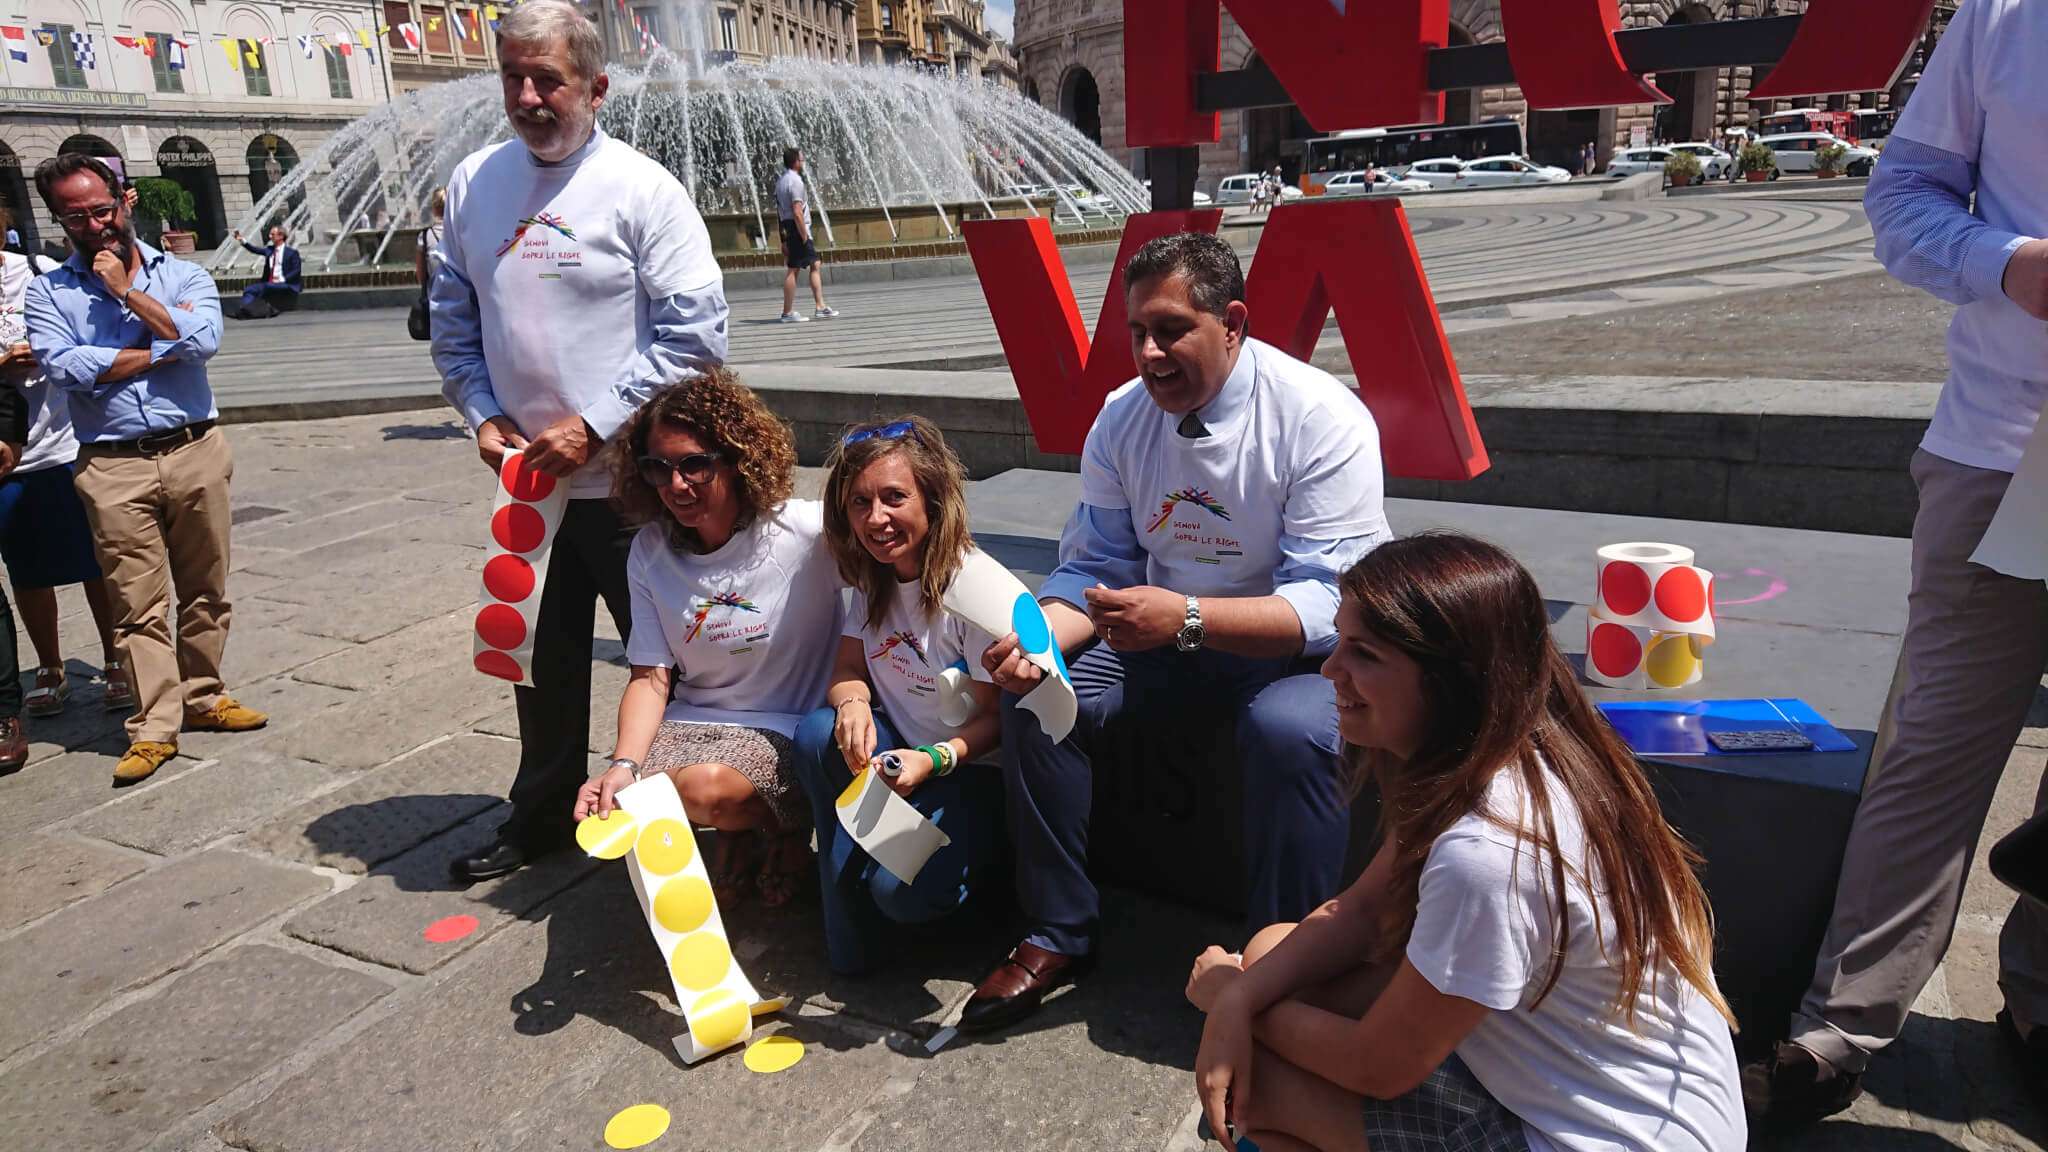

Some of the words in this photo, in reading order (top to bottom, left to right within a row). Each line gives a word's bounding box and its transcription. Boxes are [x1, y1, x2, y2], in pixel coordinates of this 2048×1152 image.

[158, 152, 180, 162] PATEK
[181, 152, 213, 162] PHILIPPE
[1173, 521, 1200, 530] GENOVA
[1201, 537, 1212, 545] LE
